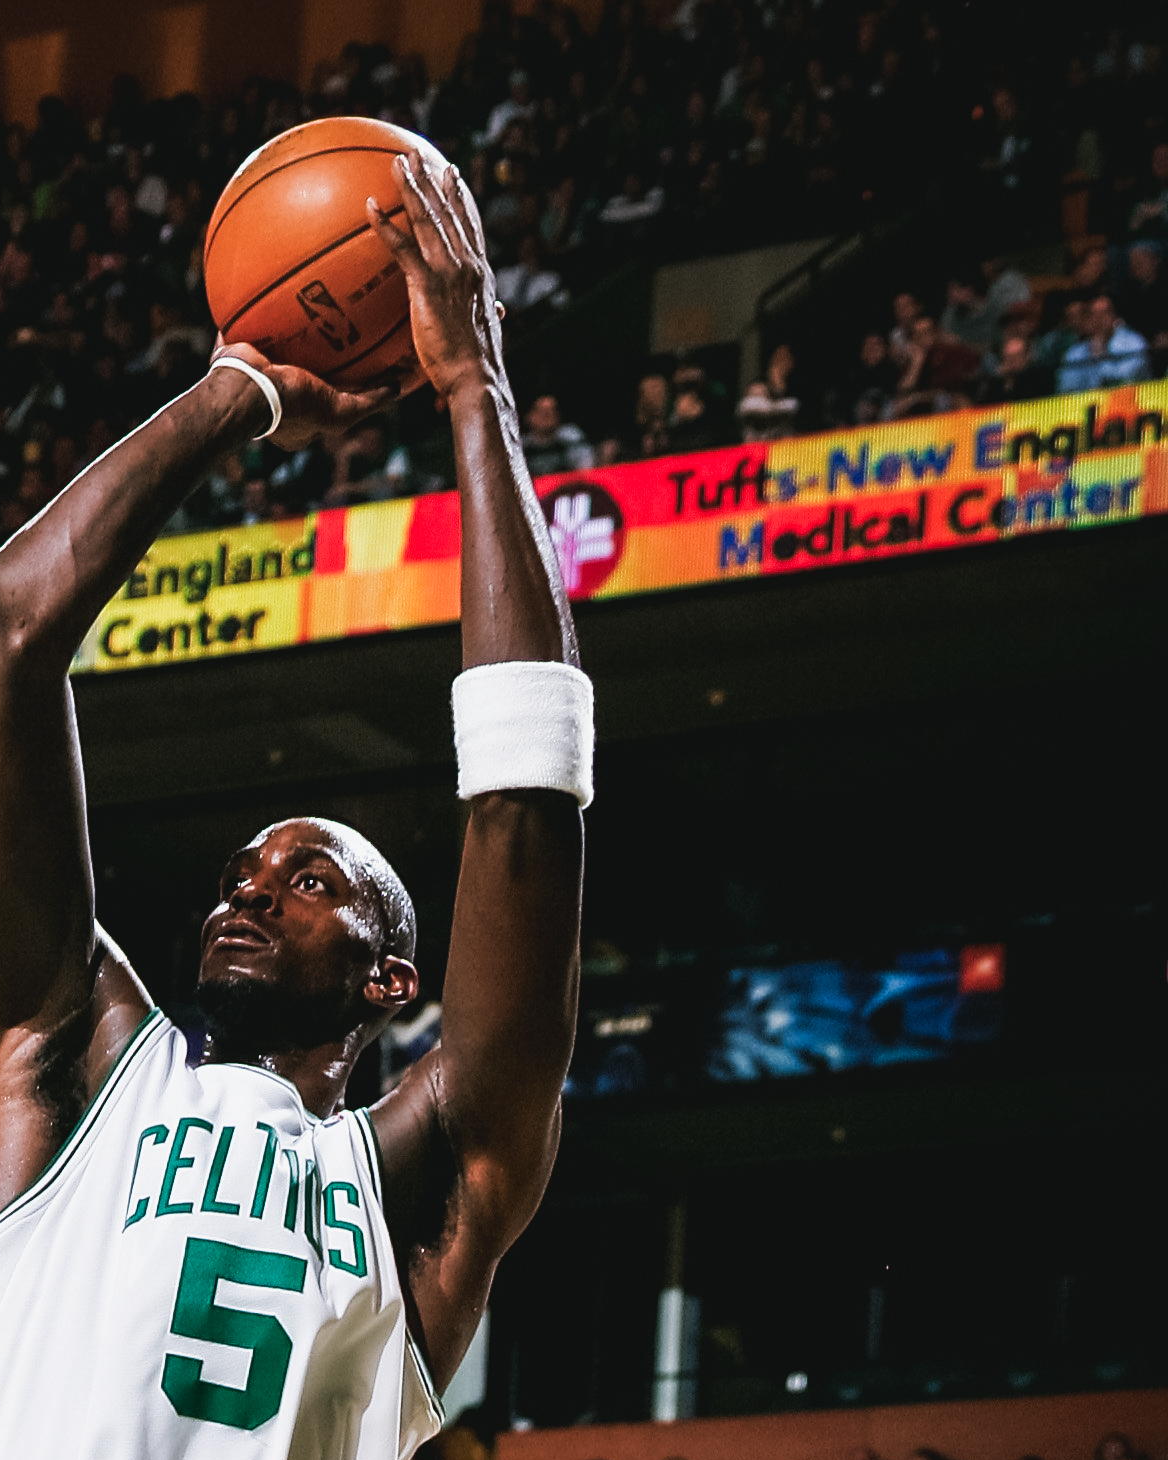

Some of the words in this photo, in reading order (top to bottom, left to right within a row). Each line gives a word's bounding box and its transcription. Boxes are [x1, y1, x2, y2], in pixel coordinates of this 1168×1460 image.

[667, 440, 958, 515] Tufts-New
[974, 403, 1168, 473] Englan
[717, 490, 928, 572] Medical
[946, 478, 1140, 538] Center
[100, 606, 266, 658] Center
[160, 1237, 308, 1431] 5
